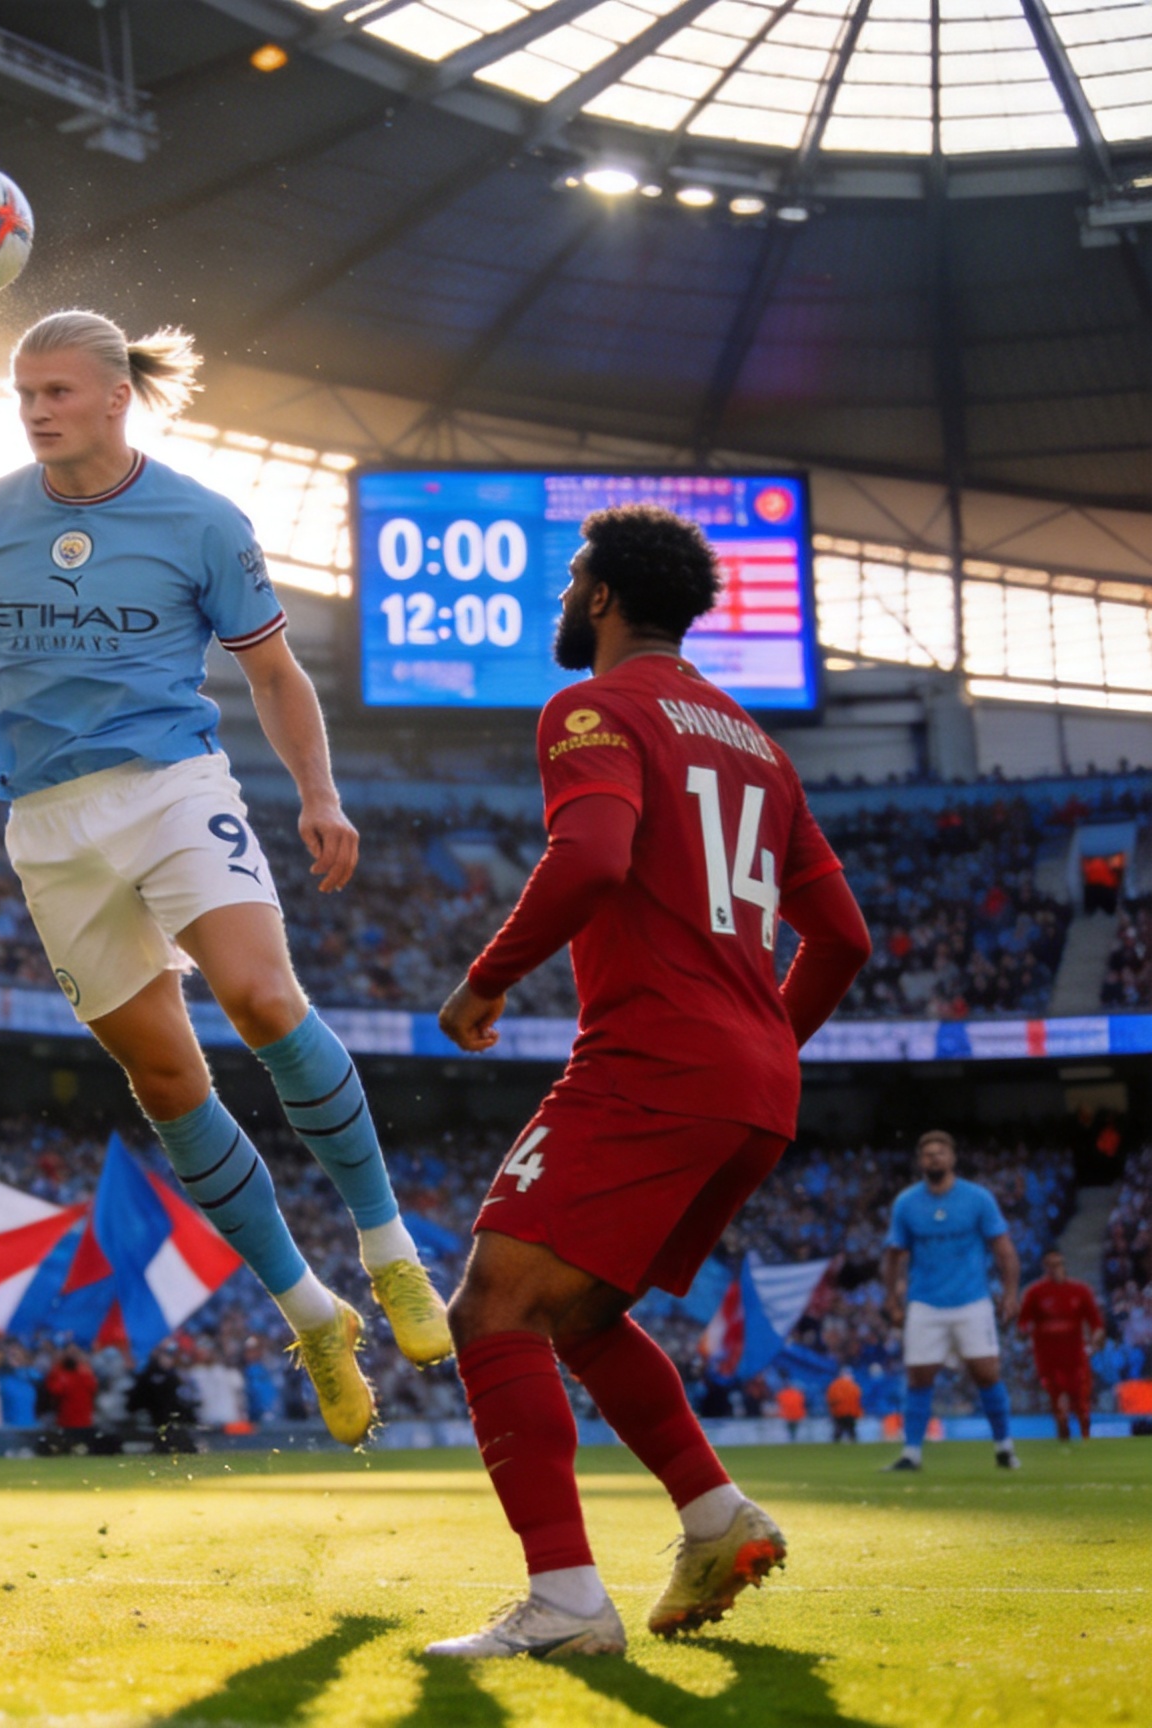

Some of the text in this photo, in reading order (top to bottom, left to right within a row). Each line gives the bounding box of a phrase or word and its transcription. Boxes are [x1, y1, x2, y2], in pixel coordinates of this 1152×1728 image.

[378, 518, 527, 582] 0:00
[381, 592, 522, 647] 12:00
[208, 813, 248, 858] 9
[686, 765, 780, 952] 14
